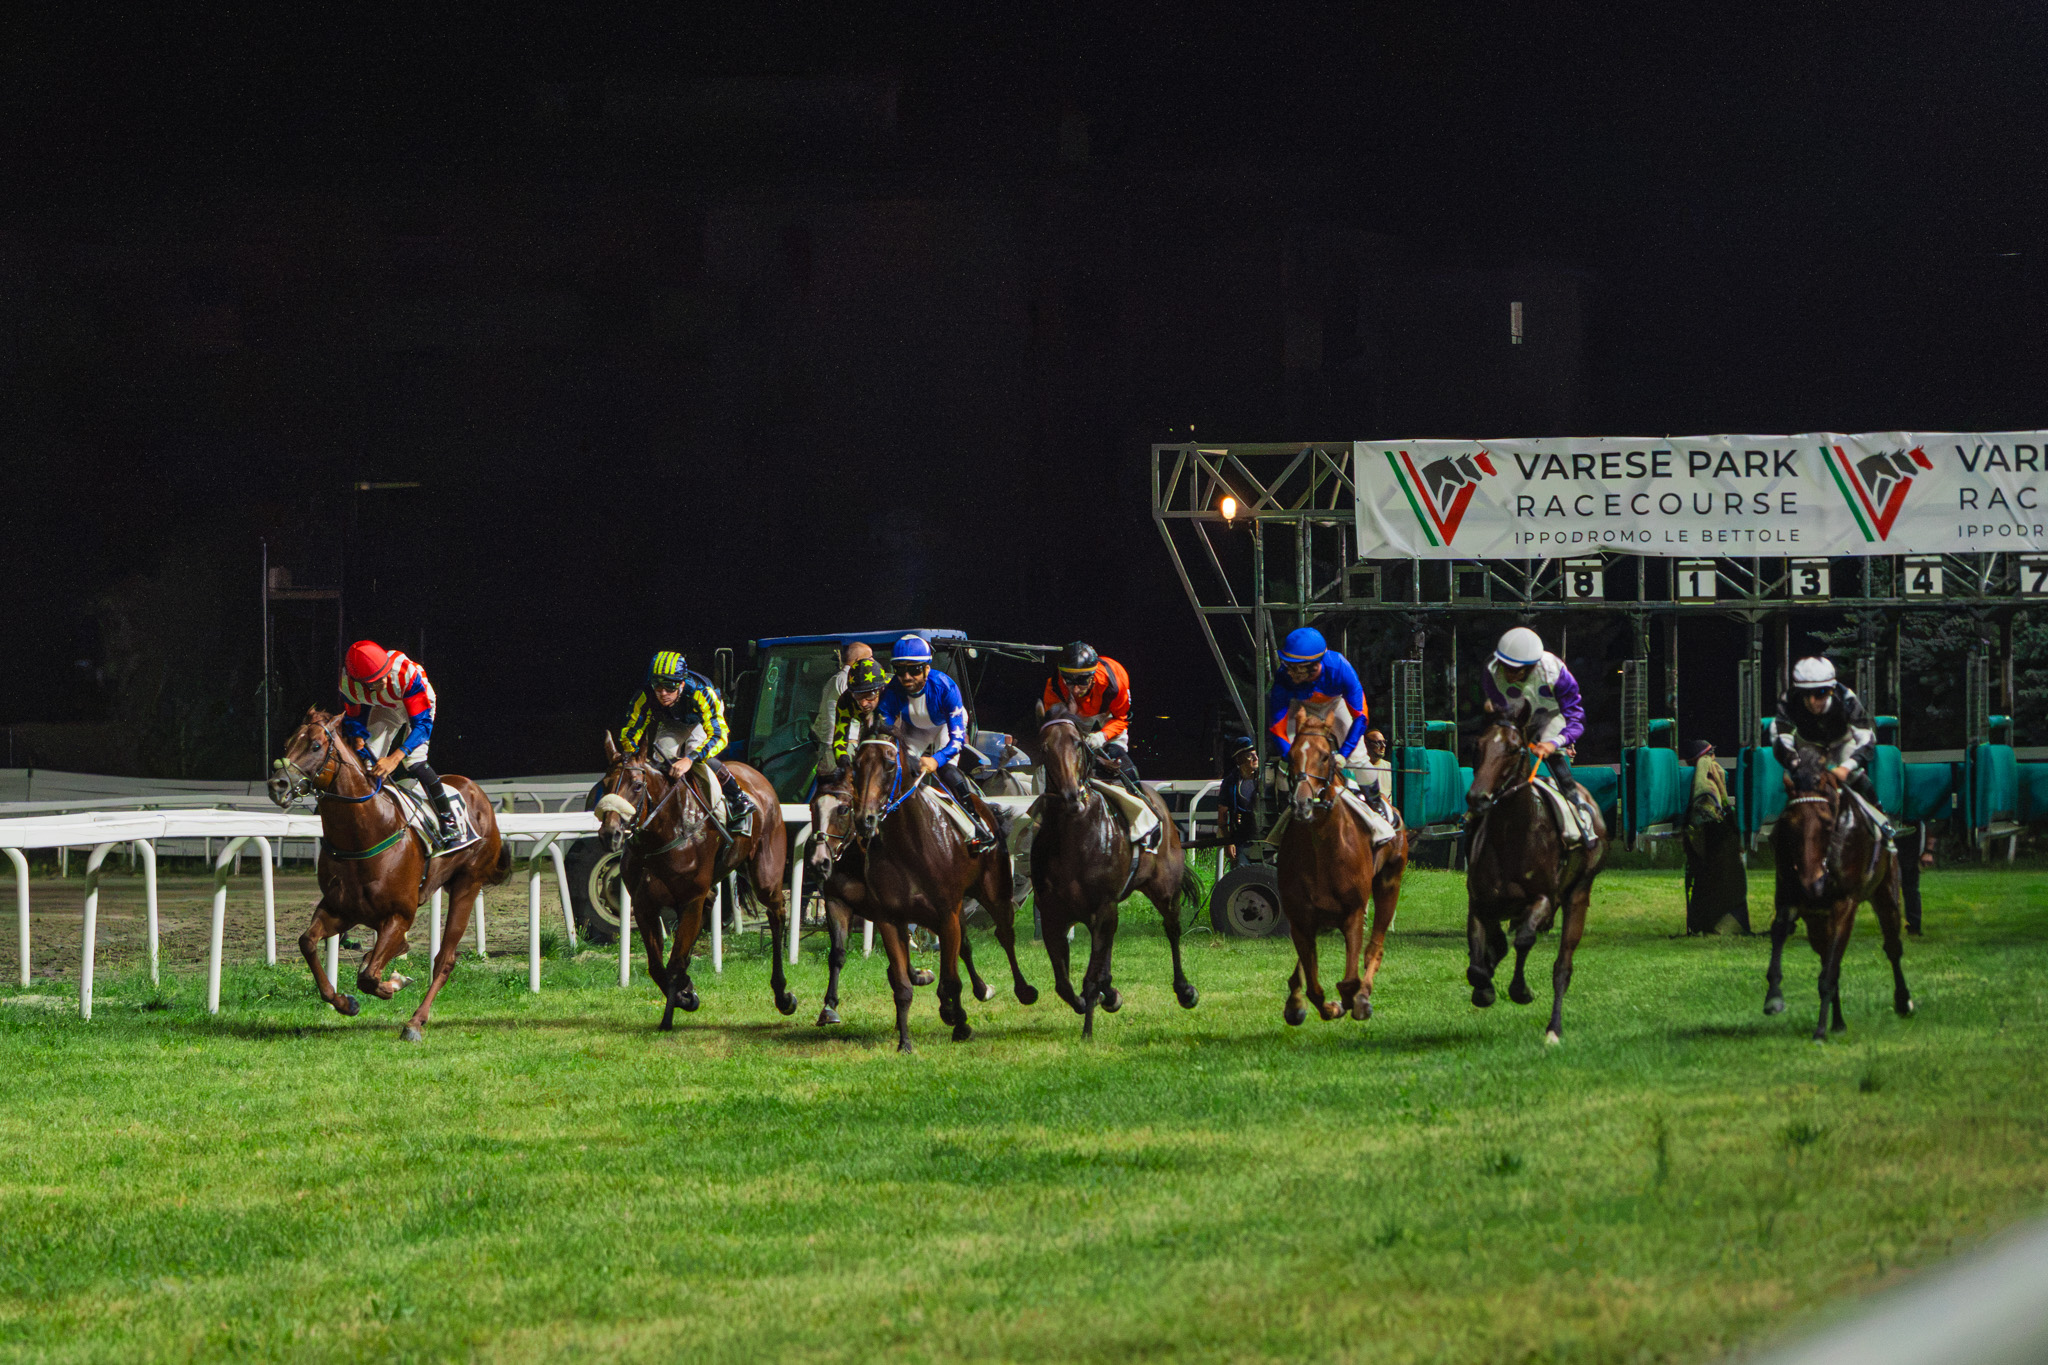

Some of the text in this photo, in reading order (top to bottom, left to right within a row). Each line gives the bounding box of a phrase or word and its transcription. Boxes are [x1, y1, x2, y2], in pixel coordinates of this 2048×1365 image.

[1513, 449, 1799, 480] VARESE PARK
[1955, 444, 2048, 472] VAR
[1516, 492, 1798, 517] RACECOURSE
[1515, 529, 1800, 544] IPPODROMO LE BETTOLE
[1958, 524, 2044, 538] IPPODR
[1573, 571, 1594, 598] 8
[1689, 571, 1700, 597] 1
[1800, 568, 1821, 596] 3
[1912, 566, 1934, 594] 4
[2028, 565, 2048, 593] 7
